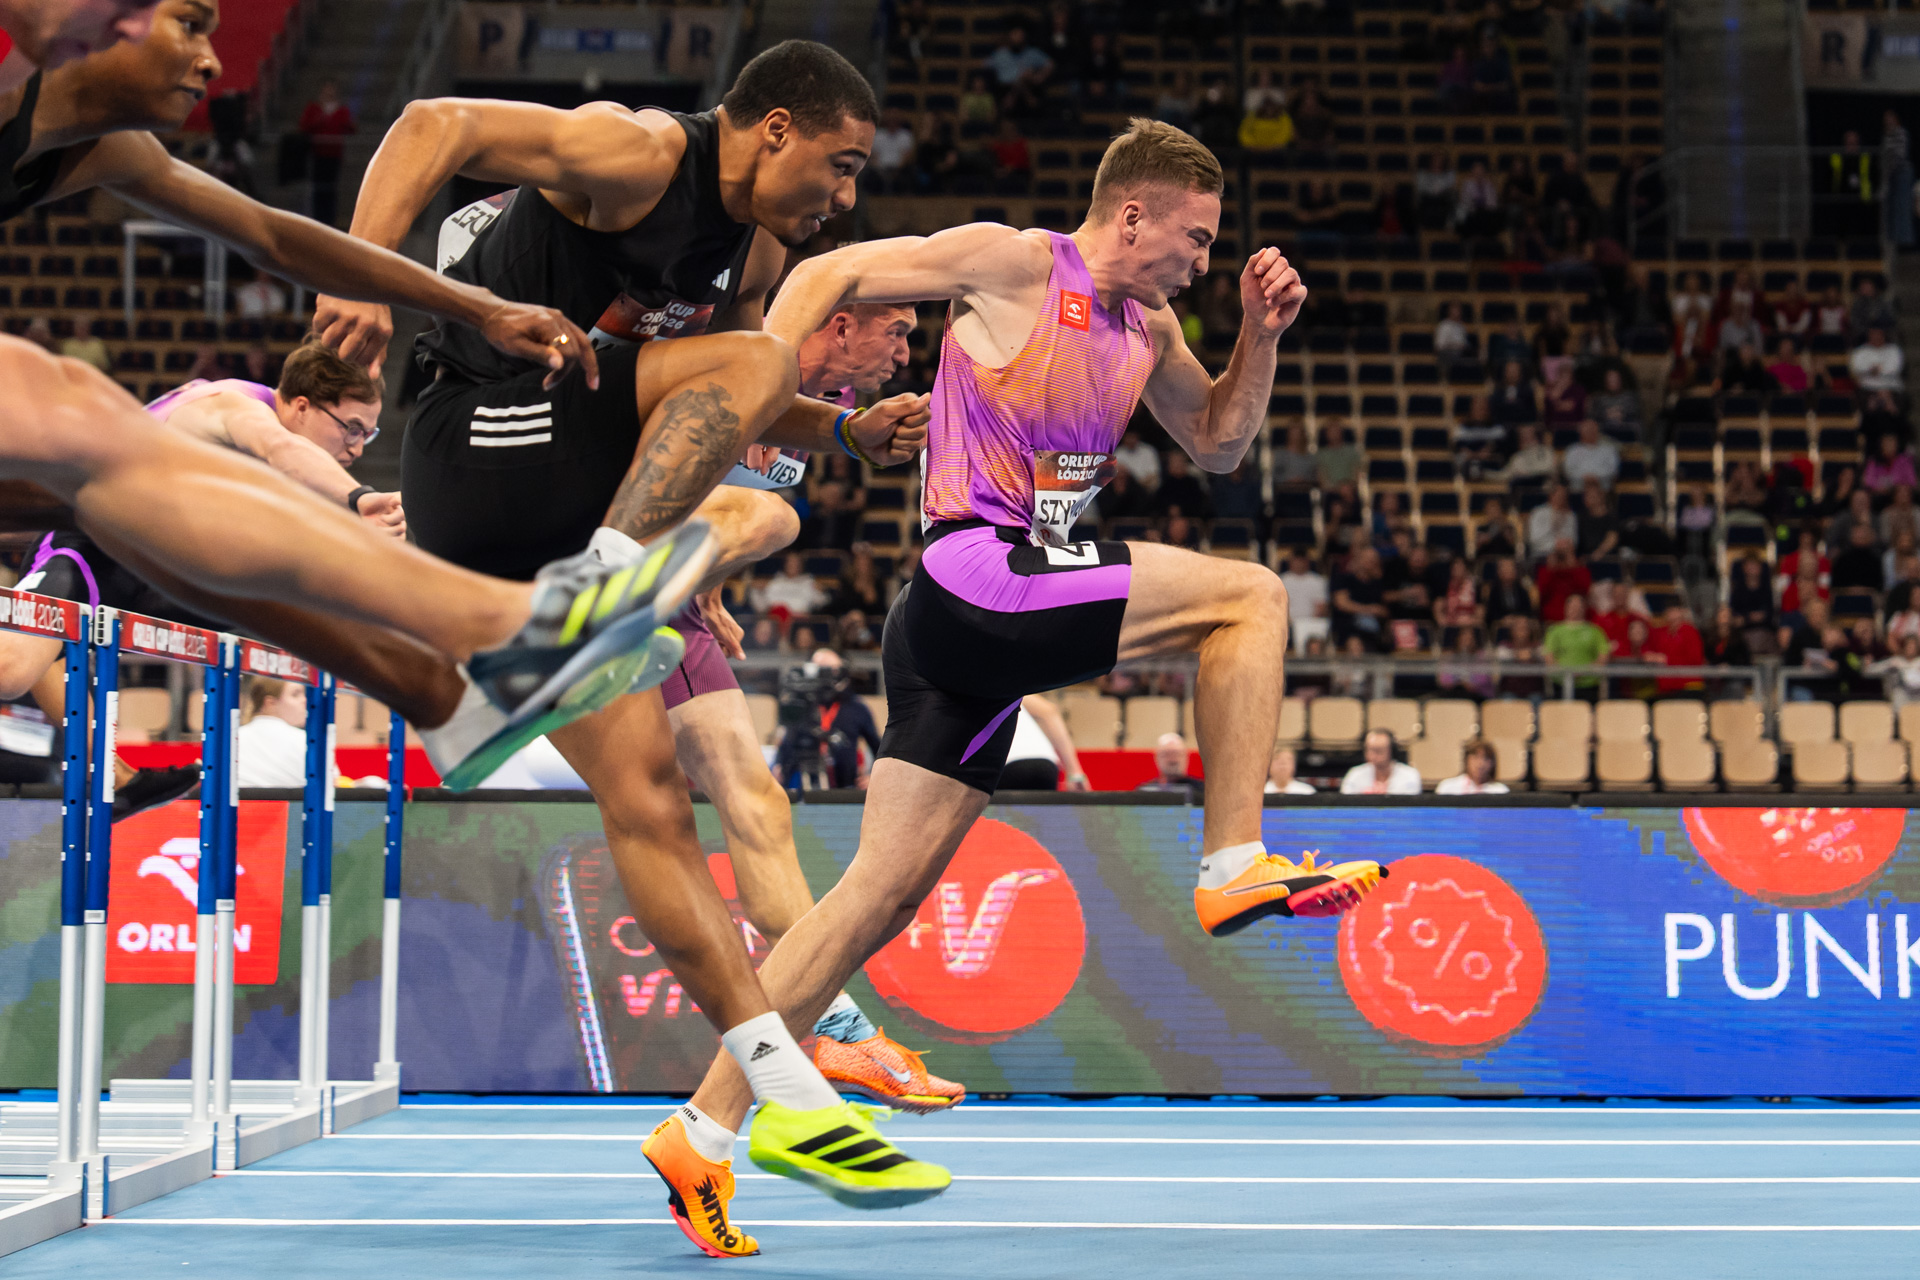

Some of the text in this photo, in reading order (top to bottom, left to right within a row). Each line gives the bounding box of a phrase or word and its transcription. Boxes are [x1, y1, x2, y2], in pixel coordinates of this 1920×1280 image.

[669, 303, 696, 318] CUP
[37, 603, 66, 634] 2026
[117, 922, 252, 953] ORLN
[693, 1173, 738, 1249] NITRO
